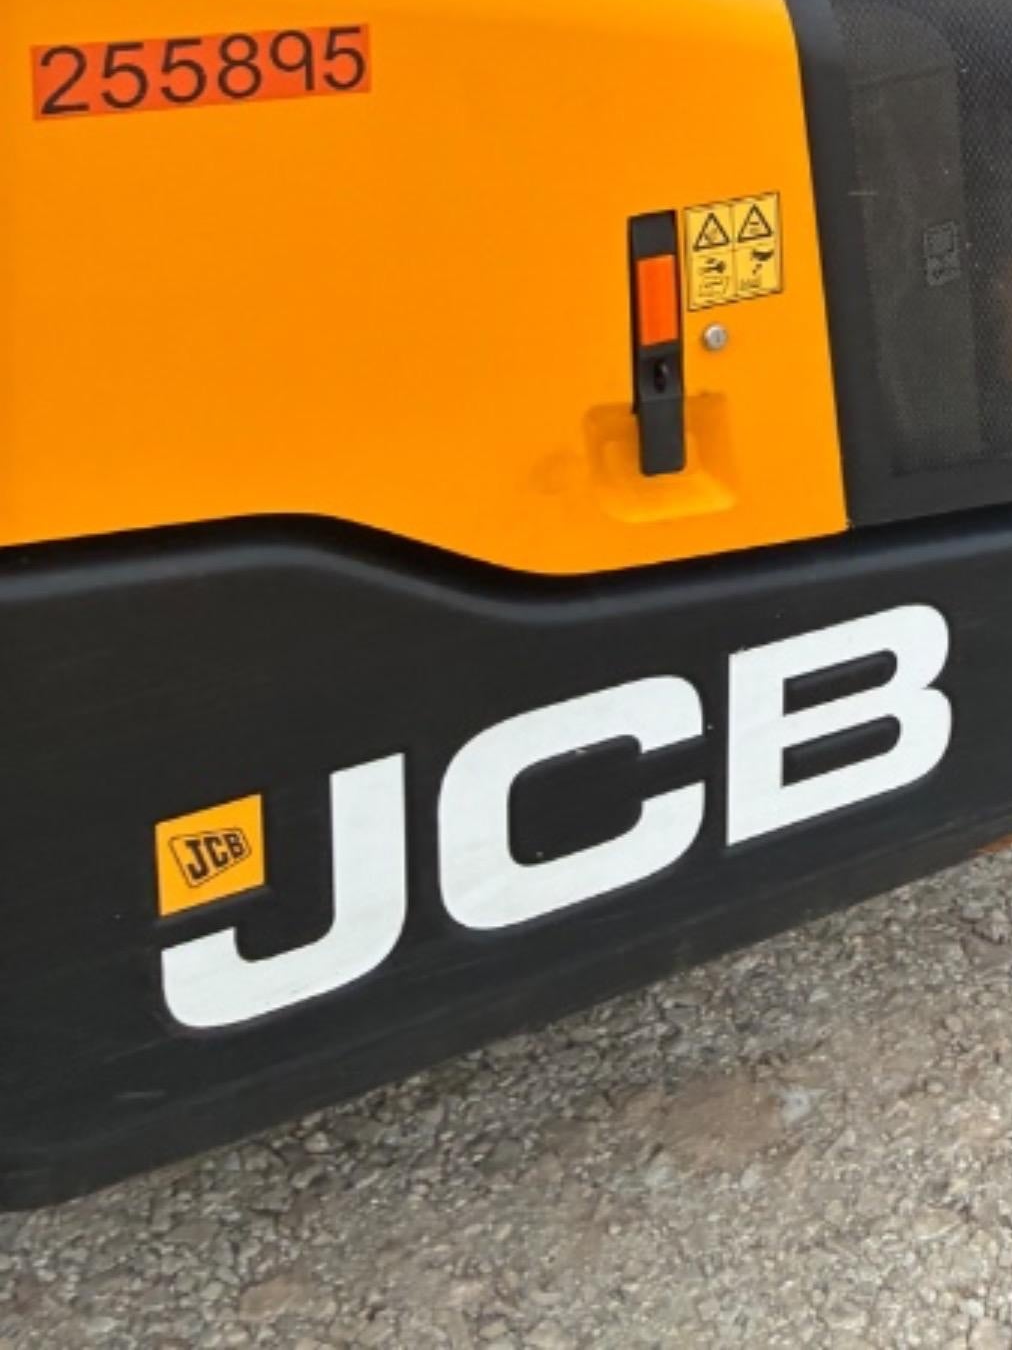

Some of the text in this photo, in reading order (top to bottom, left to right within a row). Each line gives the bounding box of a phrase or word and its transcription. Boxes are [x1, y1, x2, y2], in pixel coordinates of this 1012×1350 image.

[39, 26, 367, 116] 255895
[160, 603, 953, 1029] JCB
[185, 832, 245, 881] JCB
